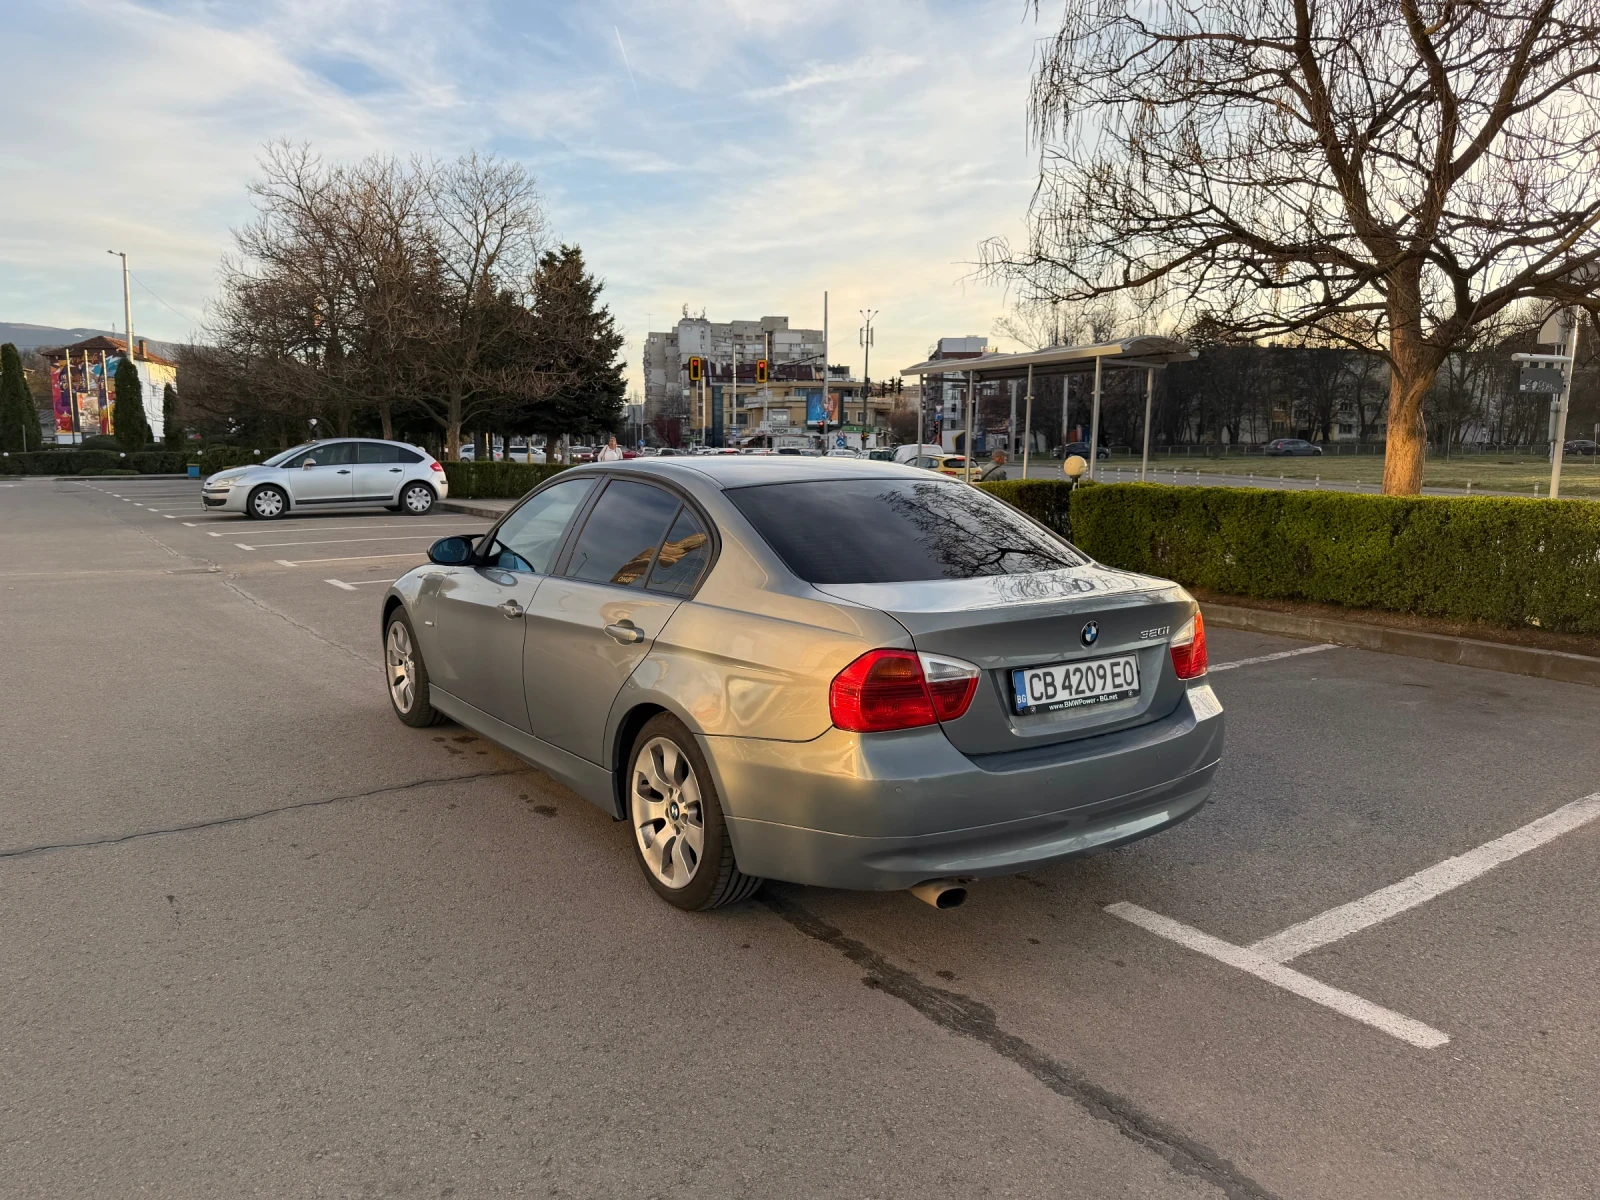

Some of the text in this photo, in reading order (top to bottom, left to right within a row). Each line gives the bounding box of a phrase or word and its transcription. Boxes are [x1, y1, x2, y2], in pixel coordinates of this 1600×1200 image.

[1139, 626, 1170, 639] 320i
[1029, 660, 1134, 701] CB 4209 EO
[1016, 694, 1027, 704] BG
